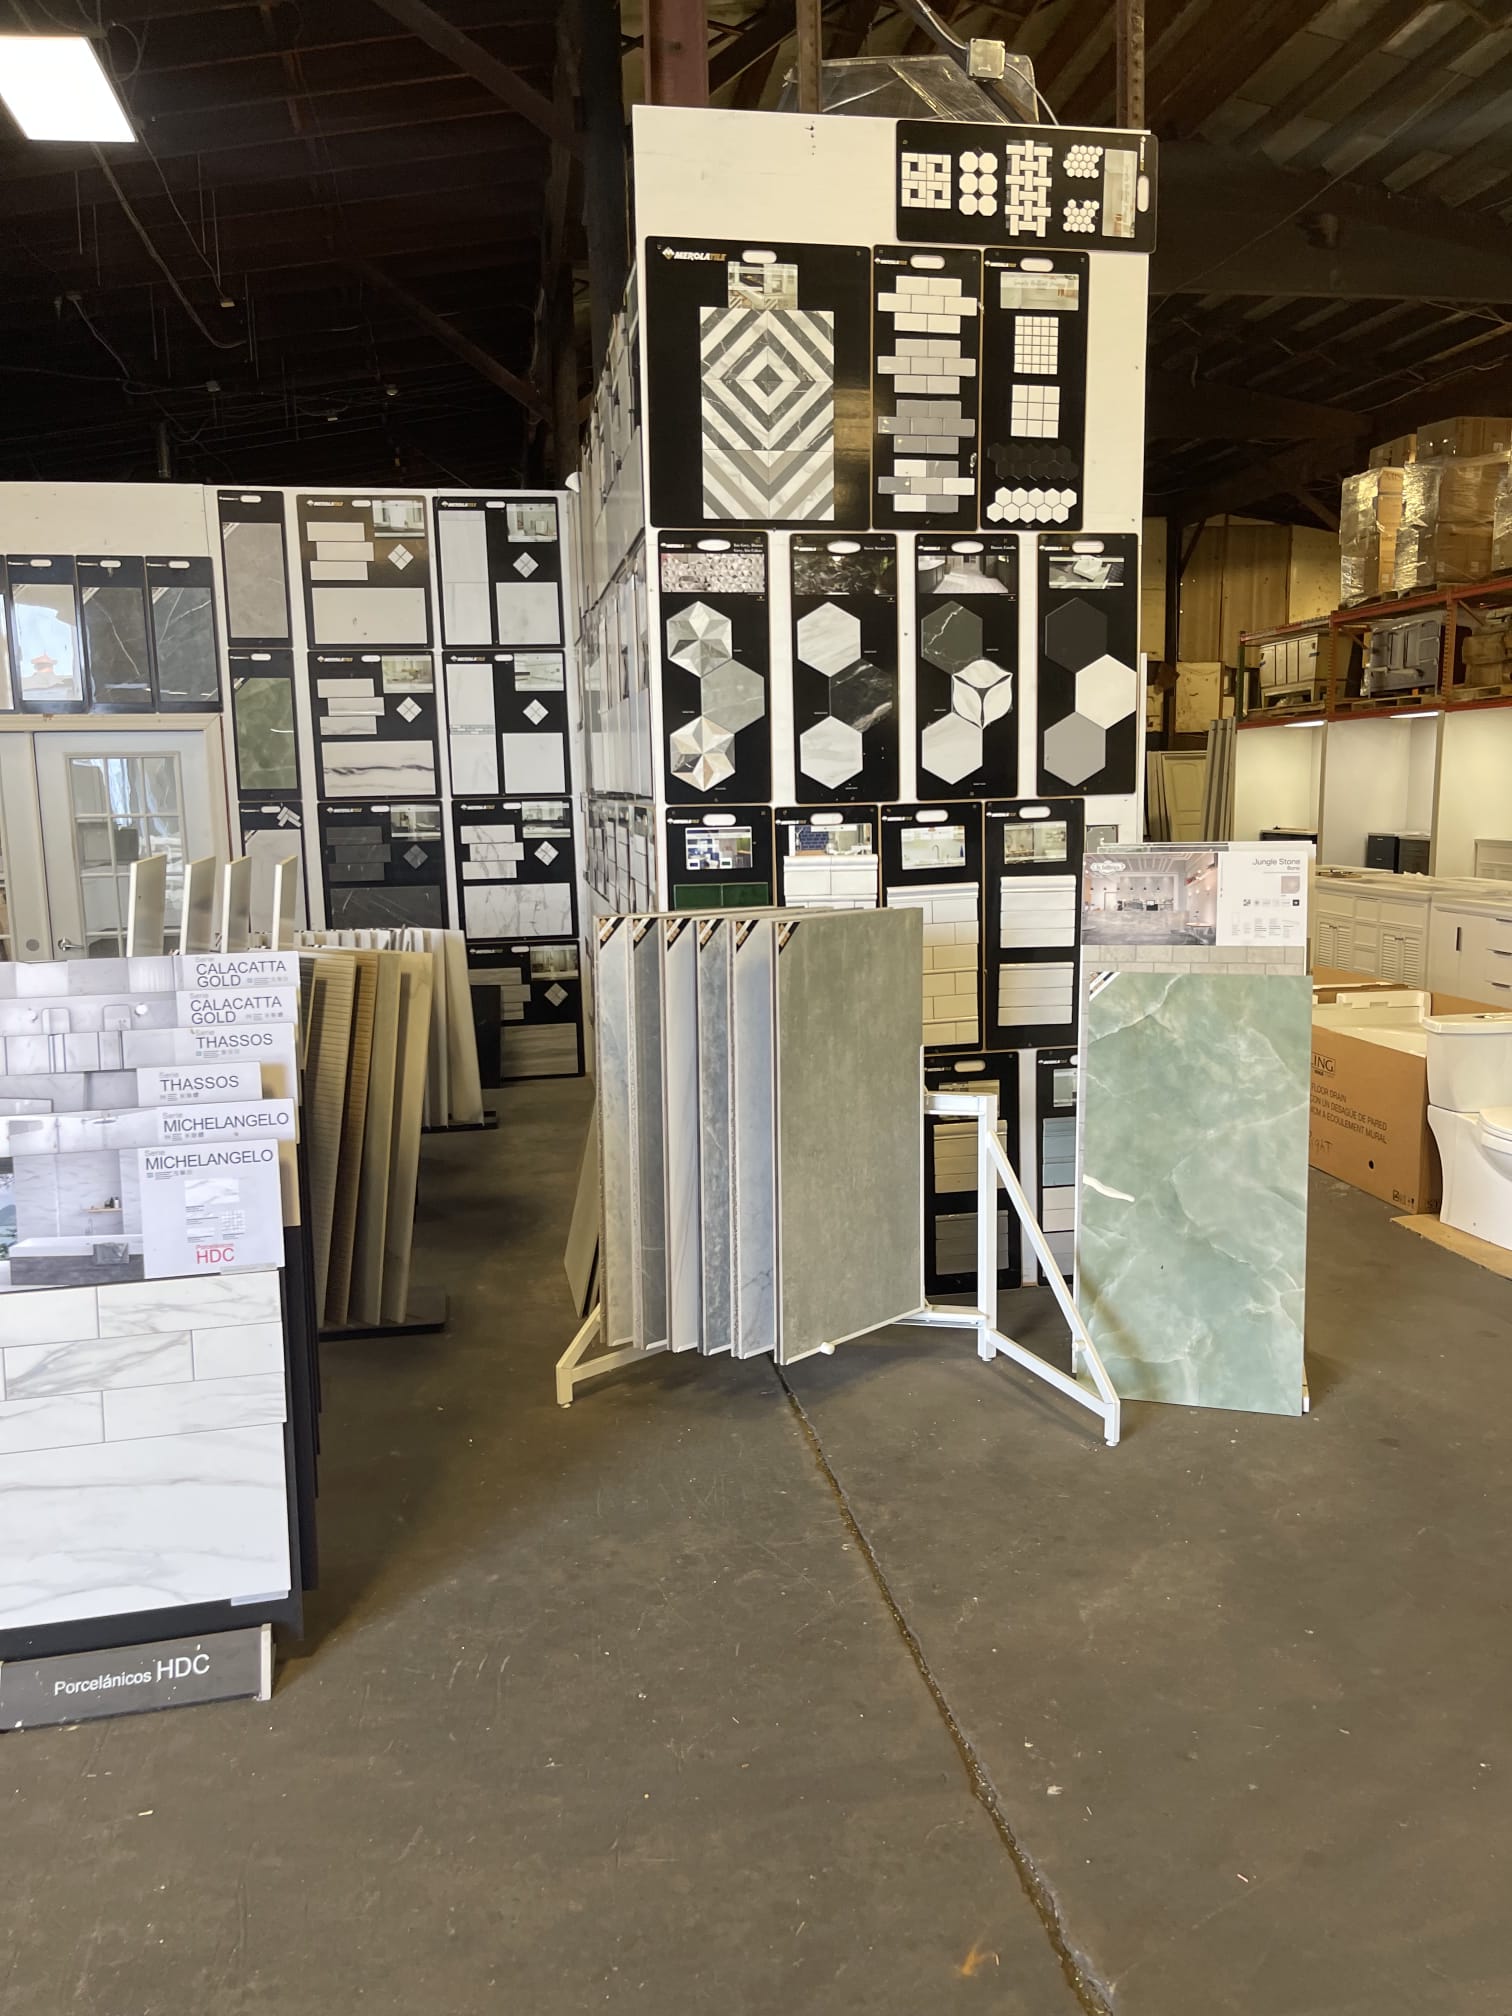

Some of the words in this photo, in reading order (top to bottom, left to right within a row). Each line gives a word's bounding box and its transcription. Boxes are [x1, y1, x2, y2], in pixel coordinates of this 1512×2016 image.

[1252, 858, 1277, 867] Jungle
[196, 960, 287, 976] CALACATTA
[197, 975, 241, 988] GOLD
[190, 996, 282, 1012] CALACATTA
[191, 1011, 236, 1025] GOLD
[196, 1033, 273, 1049] THASSOS
[160, 1075, 239, 1092] THASSOS
[164, 1112, 289, 1133] MICHELANGELO
[145, 1149, 273, 1171] MICHELANGELO
[196, 1247, 235, 1265] HDC
[54, 1669, 152, 1696] Porcelánicos
[156, 1653, 210, 1682] HDC
